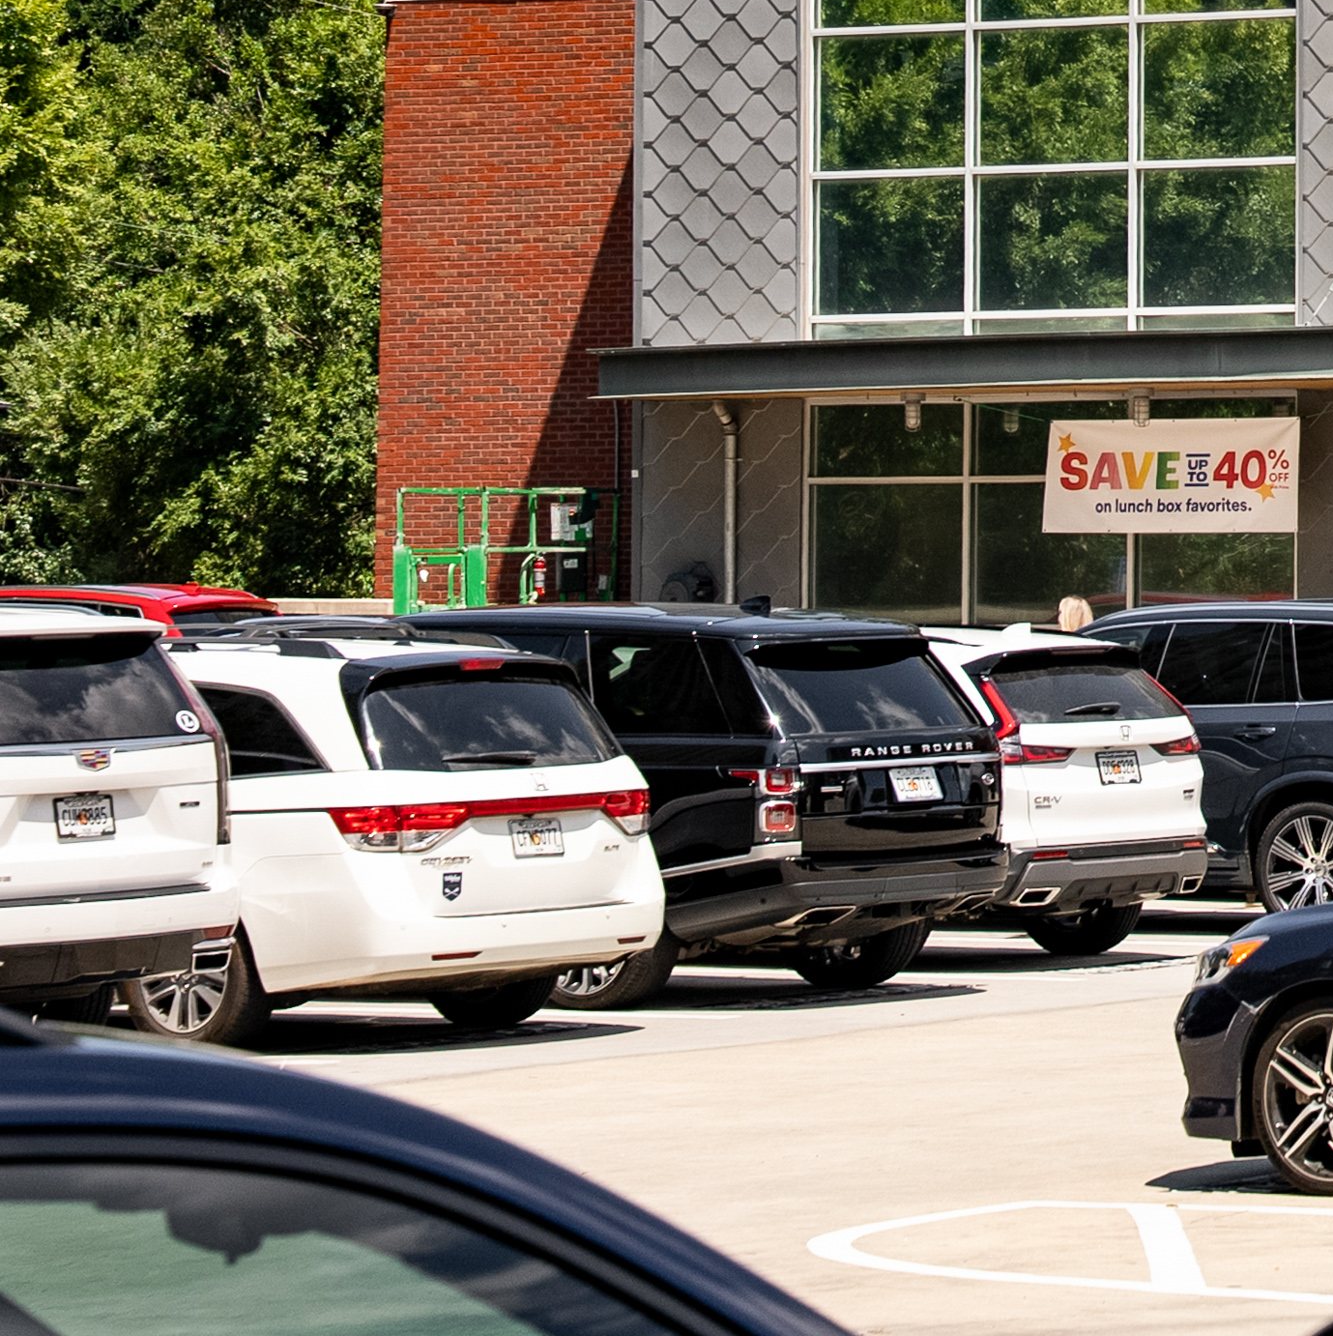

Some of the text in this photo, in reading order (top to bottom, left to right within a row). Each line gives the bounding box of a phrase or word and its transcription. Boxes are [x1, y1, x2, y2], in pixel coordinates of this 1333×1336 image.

[1060, 451, 1180, 490] SAVE
[1187, 459, 1209, 470] UP
[1187, 472, 1208, 482] TO
[1268, 472, 1289, 482] OFF
[1095, 498, 1252, 513] on lunch box favorites.
[851, 741, 974, 757] RANGE ROVER
